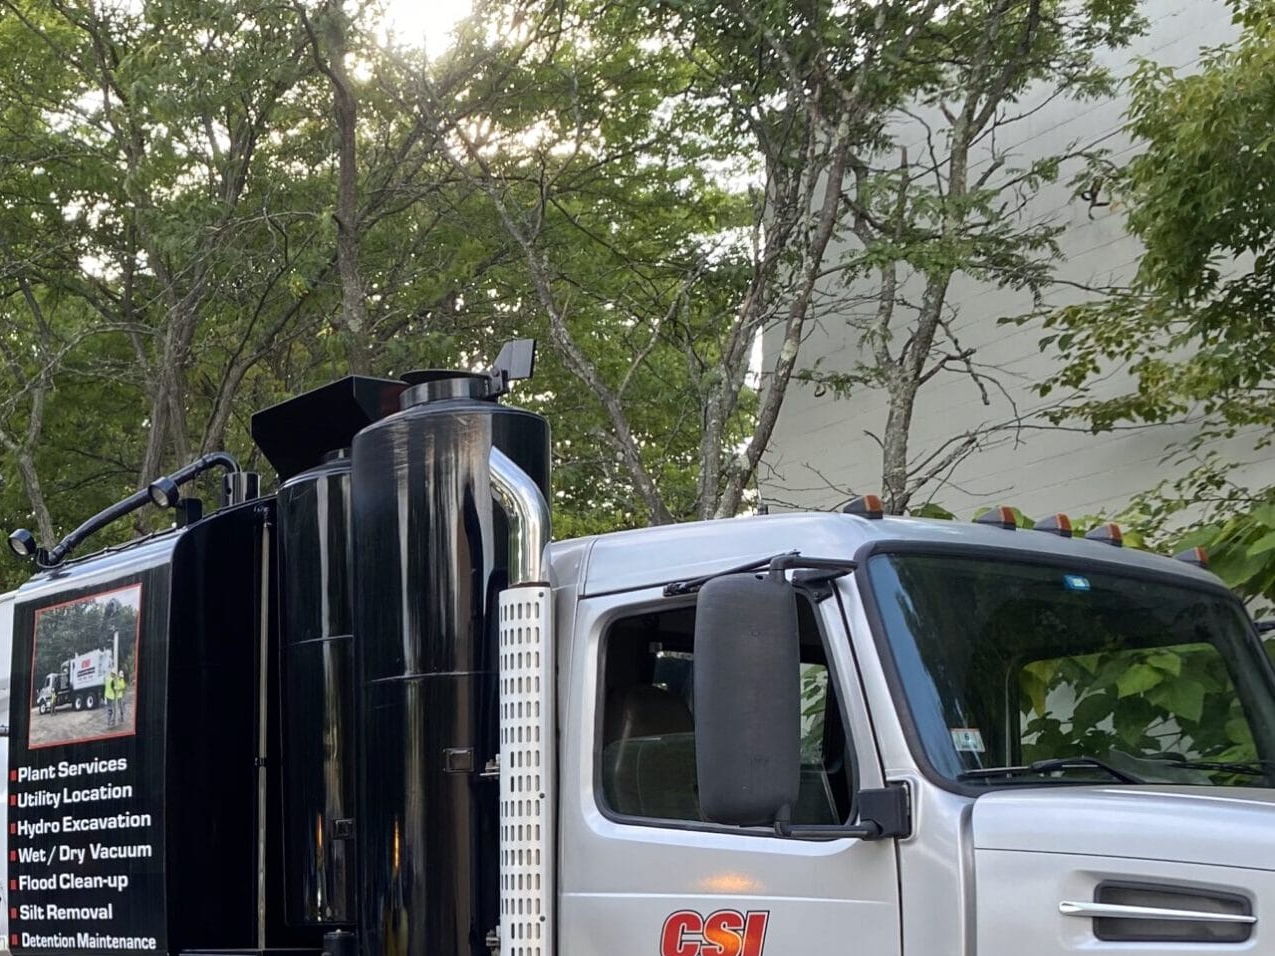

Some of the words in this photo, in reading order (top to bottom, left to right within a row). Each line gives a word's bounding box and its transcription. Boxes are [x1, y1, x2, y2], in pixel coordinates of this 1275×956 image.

[18, 765, 56, 782] Plant
[58, 757, 127, 777] Services
[18, 790, 61, 809] Utility
[63, 783, 133, 803] Location
[18, 819, 60, 839] Hydro
[63, 811, 152, 832] Excavation
[89, 843, 152, 860] Vacuum
[19, 873, 57, 891] Flood
[59, 873, 129, 892] Clean-up
[19, 904, 45, 920] Silt
[46, 903, 113, 920] Removal
[21, 932, 76, 948] Detention
[76, 932, 157, 950] Maintenance
